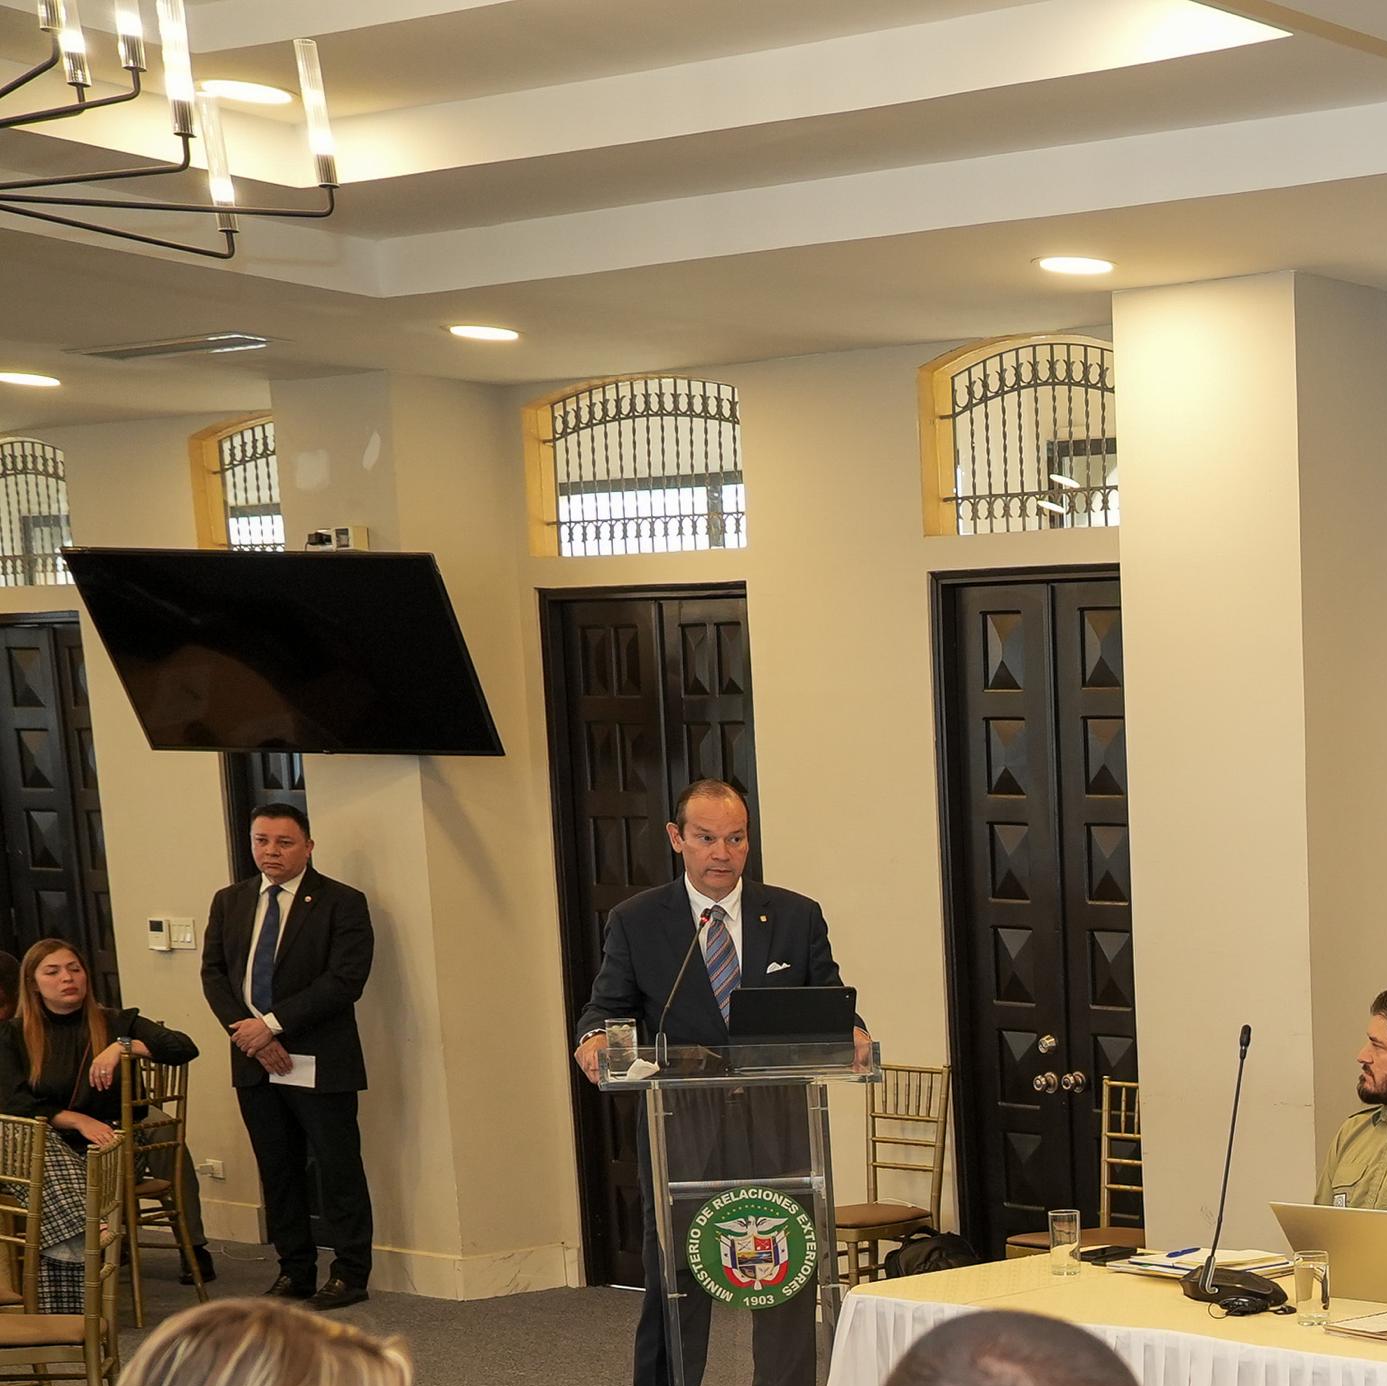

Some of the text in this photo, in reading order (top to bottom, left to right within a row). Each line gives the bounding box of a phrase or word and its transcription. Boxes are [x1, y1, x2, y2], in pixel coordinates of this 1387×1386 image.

[688, 1188, 817, 1302] MINISTERIO DE RELACIONES EXTERIORES
[743, 1294, 775, 1306] 1903
